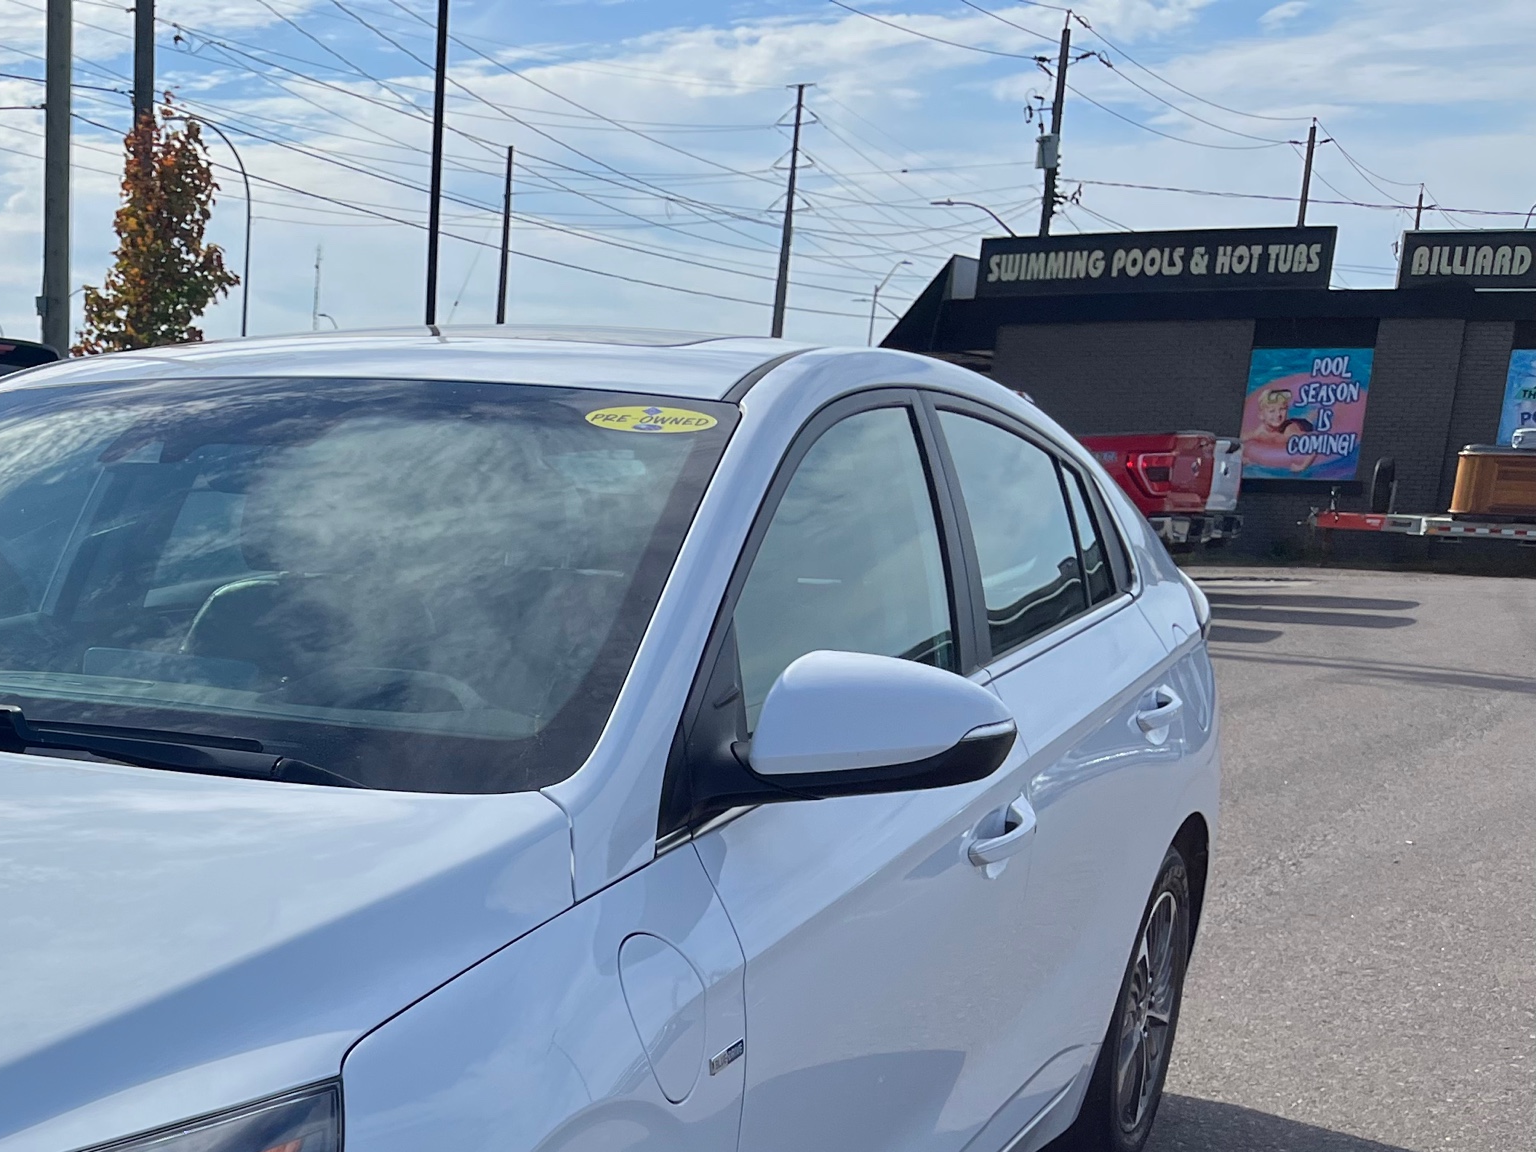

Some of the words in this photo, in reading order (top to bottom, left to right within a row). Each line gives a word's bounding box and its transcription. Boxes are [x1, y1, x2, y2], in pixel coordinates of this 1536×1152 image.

[987, 249, 1106, 283] SWIMMING
[1111, 246, 1185, 278] POOLS
[1189, 246, 1209, 275] &
[1215, 245, 1263, 275] HOT
[1267, 243, 1322, 274] TUBS
[1410, 245, 1533, 276] BILLIARD
[1311, 355, 1352, 378] POOL
[1294, 381, 1360, 407] SEASON
[590, 413, 710, 427] PRE-OWNED
[1317, 408, 1332, 432] IS
[1287, 433, 1356, 457] COMING!
